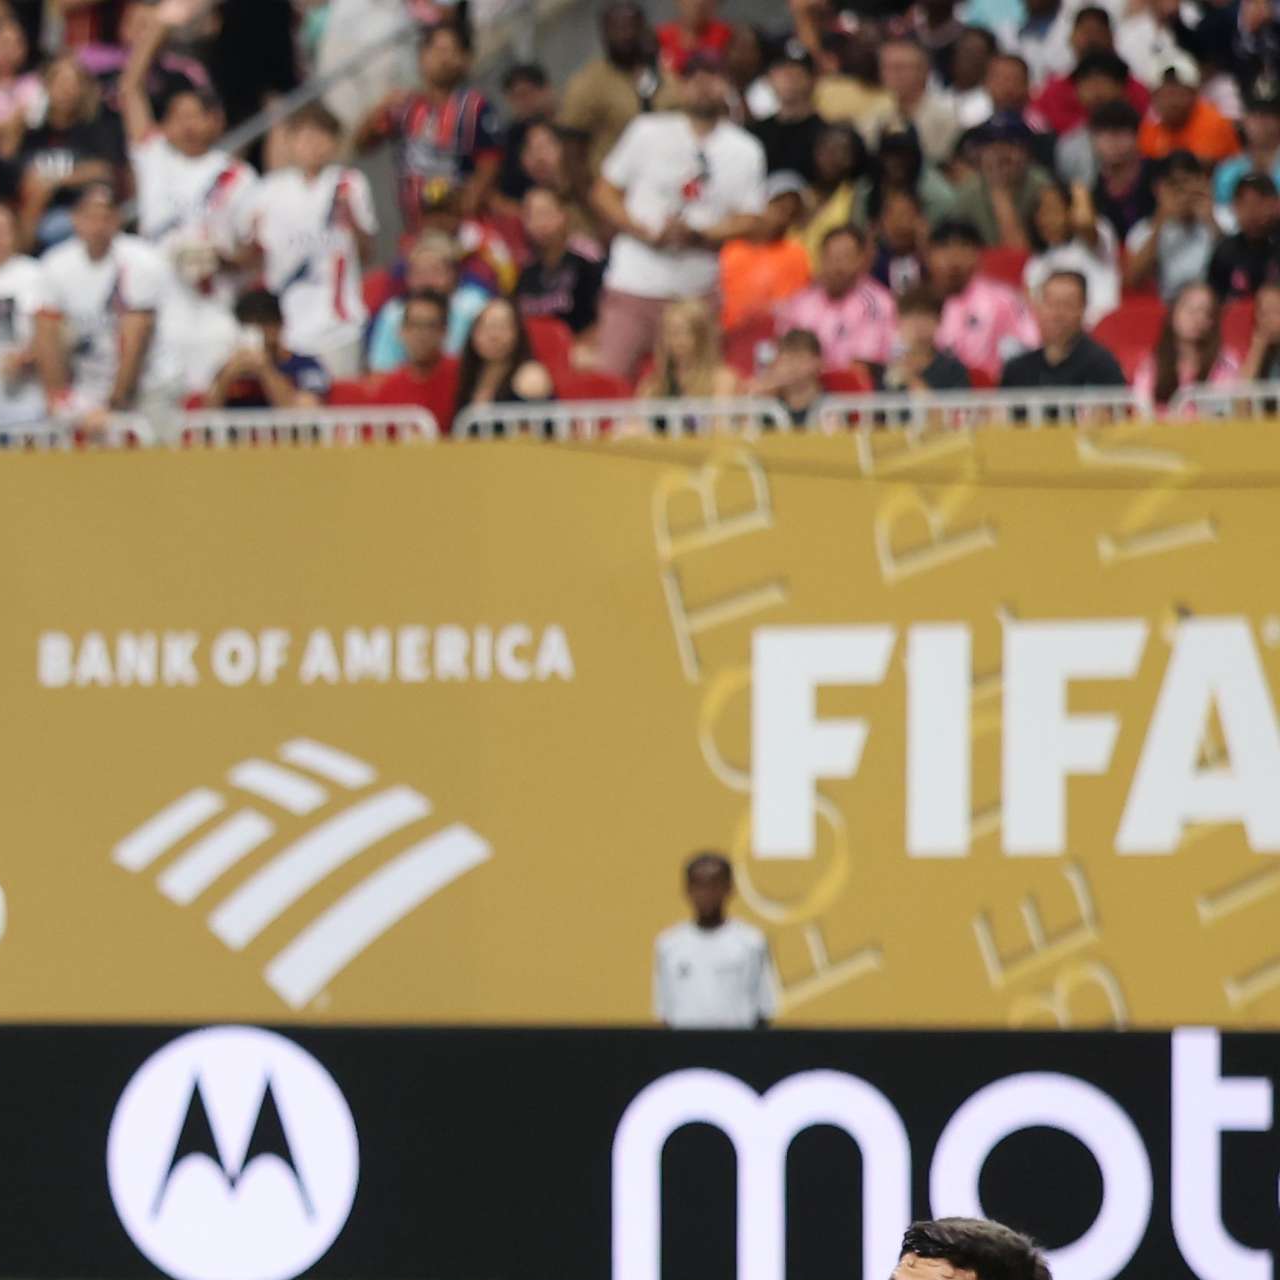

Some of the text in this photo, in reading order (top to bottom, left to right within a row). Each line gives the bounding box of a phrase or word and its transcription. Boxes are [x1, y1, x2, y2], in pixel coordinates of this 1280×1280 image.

[39, 624, 575, 688] BANK OF AMERICA
[751, 615, 1280, 860] FIFA
